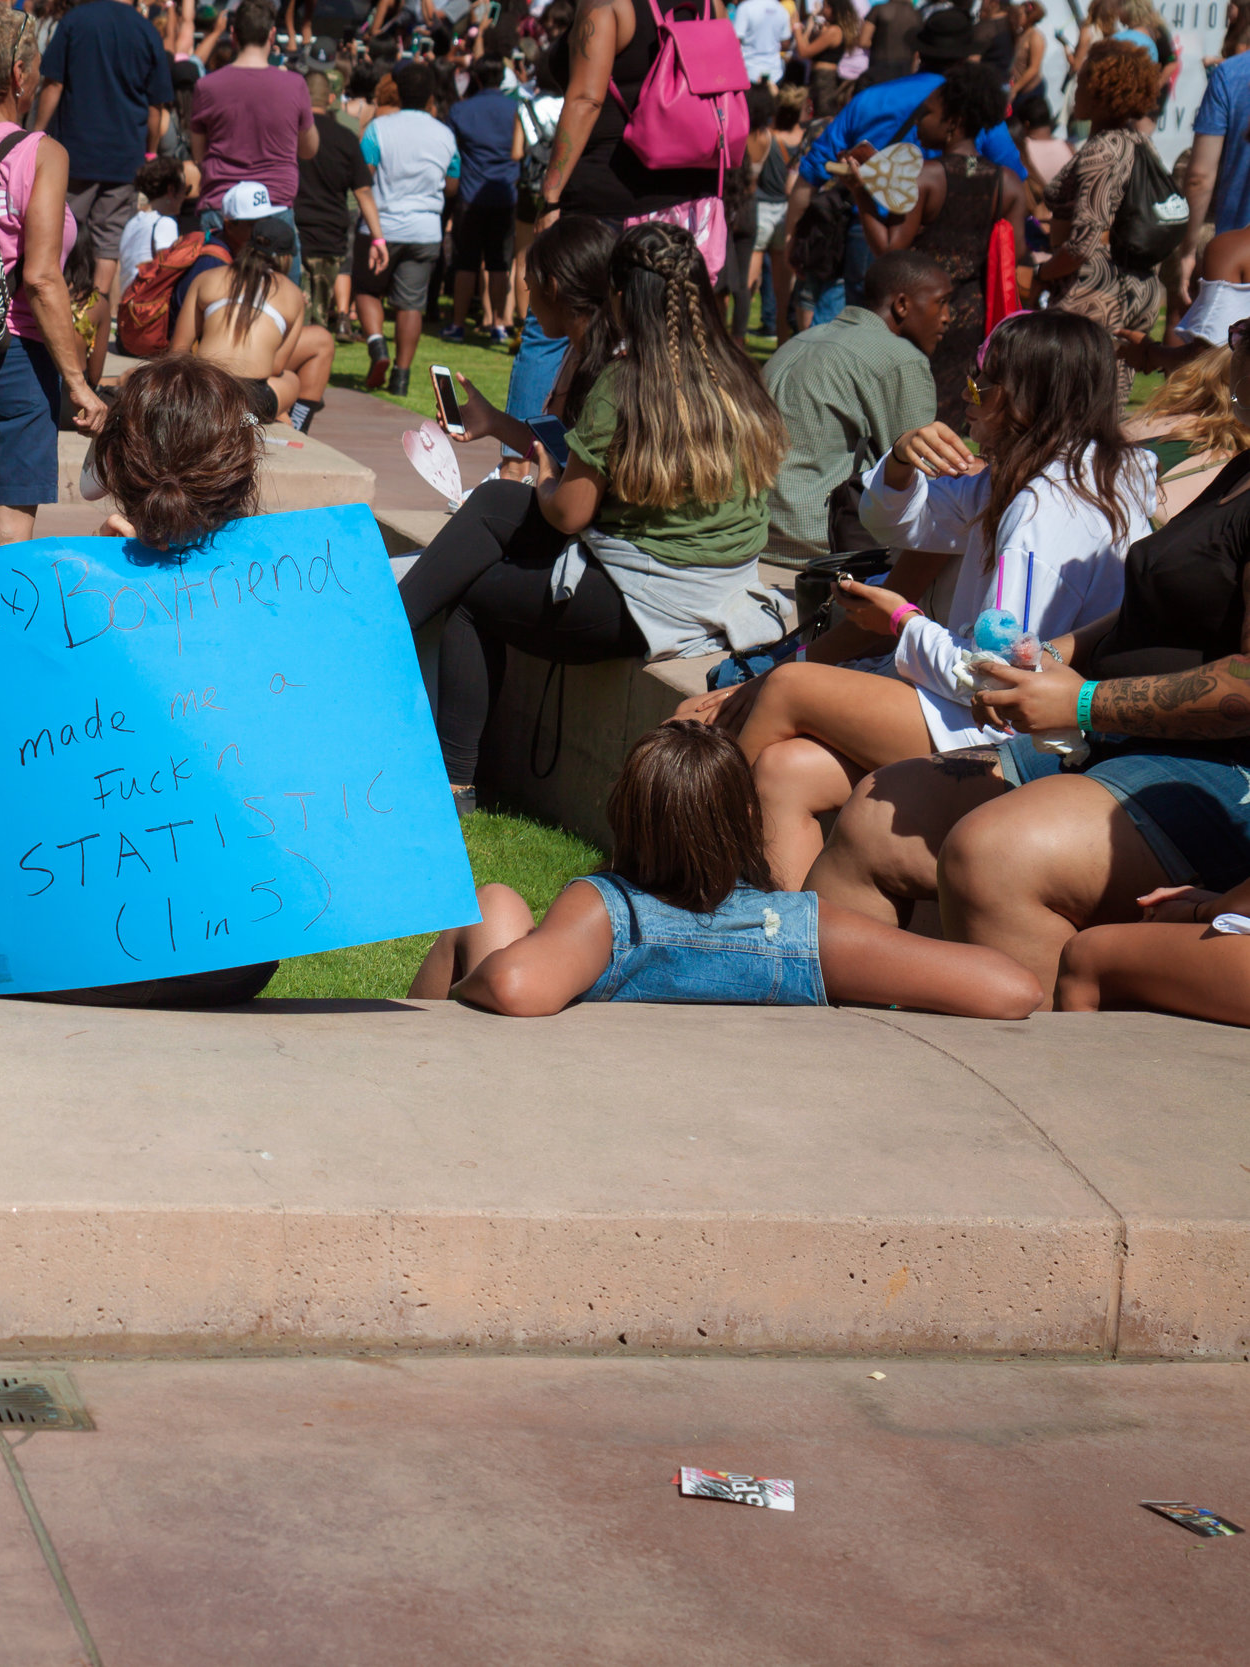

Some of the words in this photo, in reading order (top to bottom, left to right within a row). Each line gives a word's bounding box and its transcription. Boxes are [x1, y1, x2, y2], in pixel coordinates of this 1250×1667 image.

[1160, 3, 1230, 28] HIO
[50, 539, 353, 656] Boyfriend
[19, 697, 136, 767] made
[170, 686, 228, 719] me
[268, 671, 307, 696] a
[19, 770, 394, 897] STATISTIC
[201, 910, 230, 940] in
[727, 1474, 765, 1507] SPO
